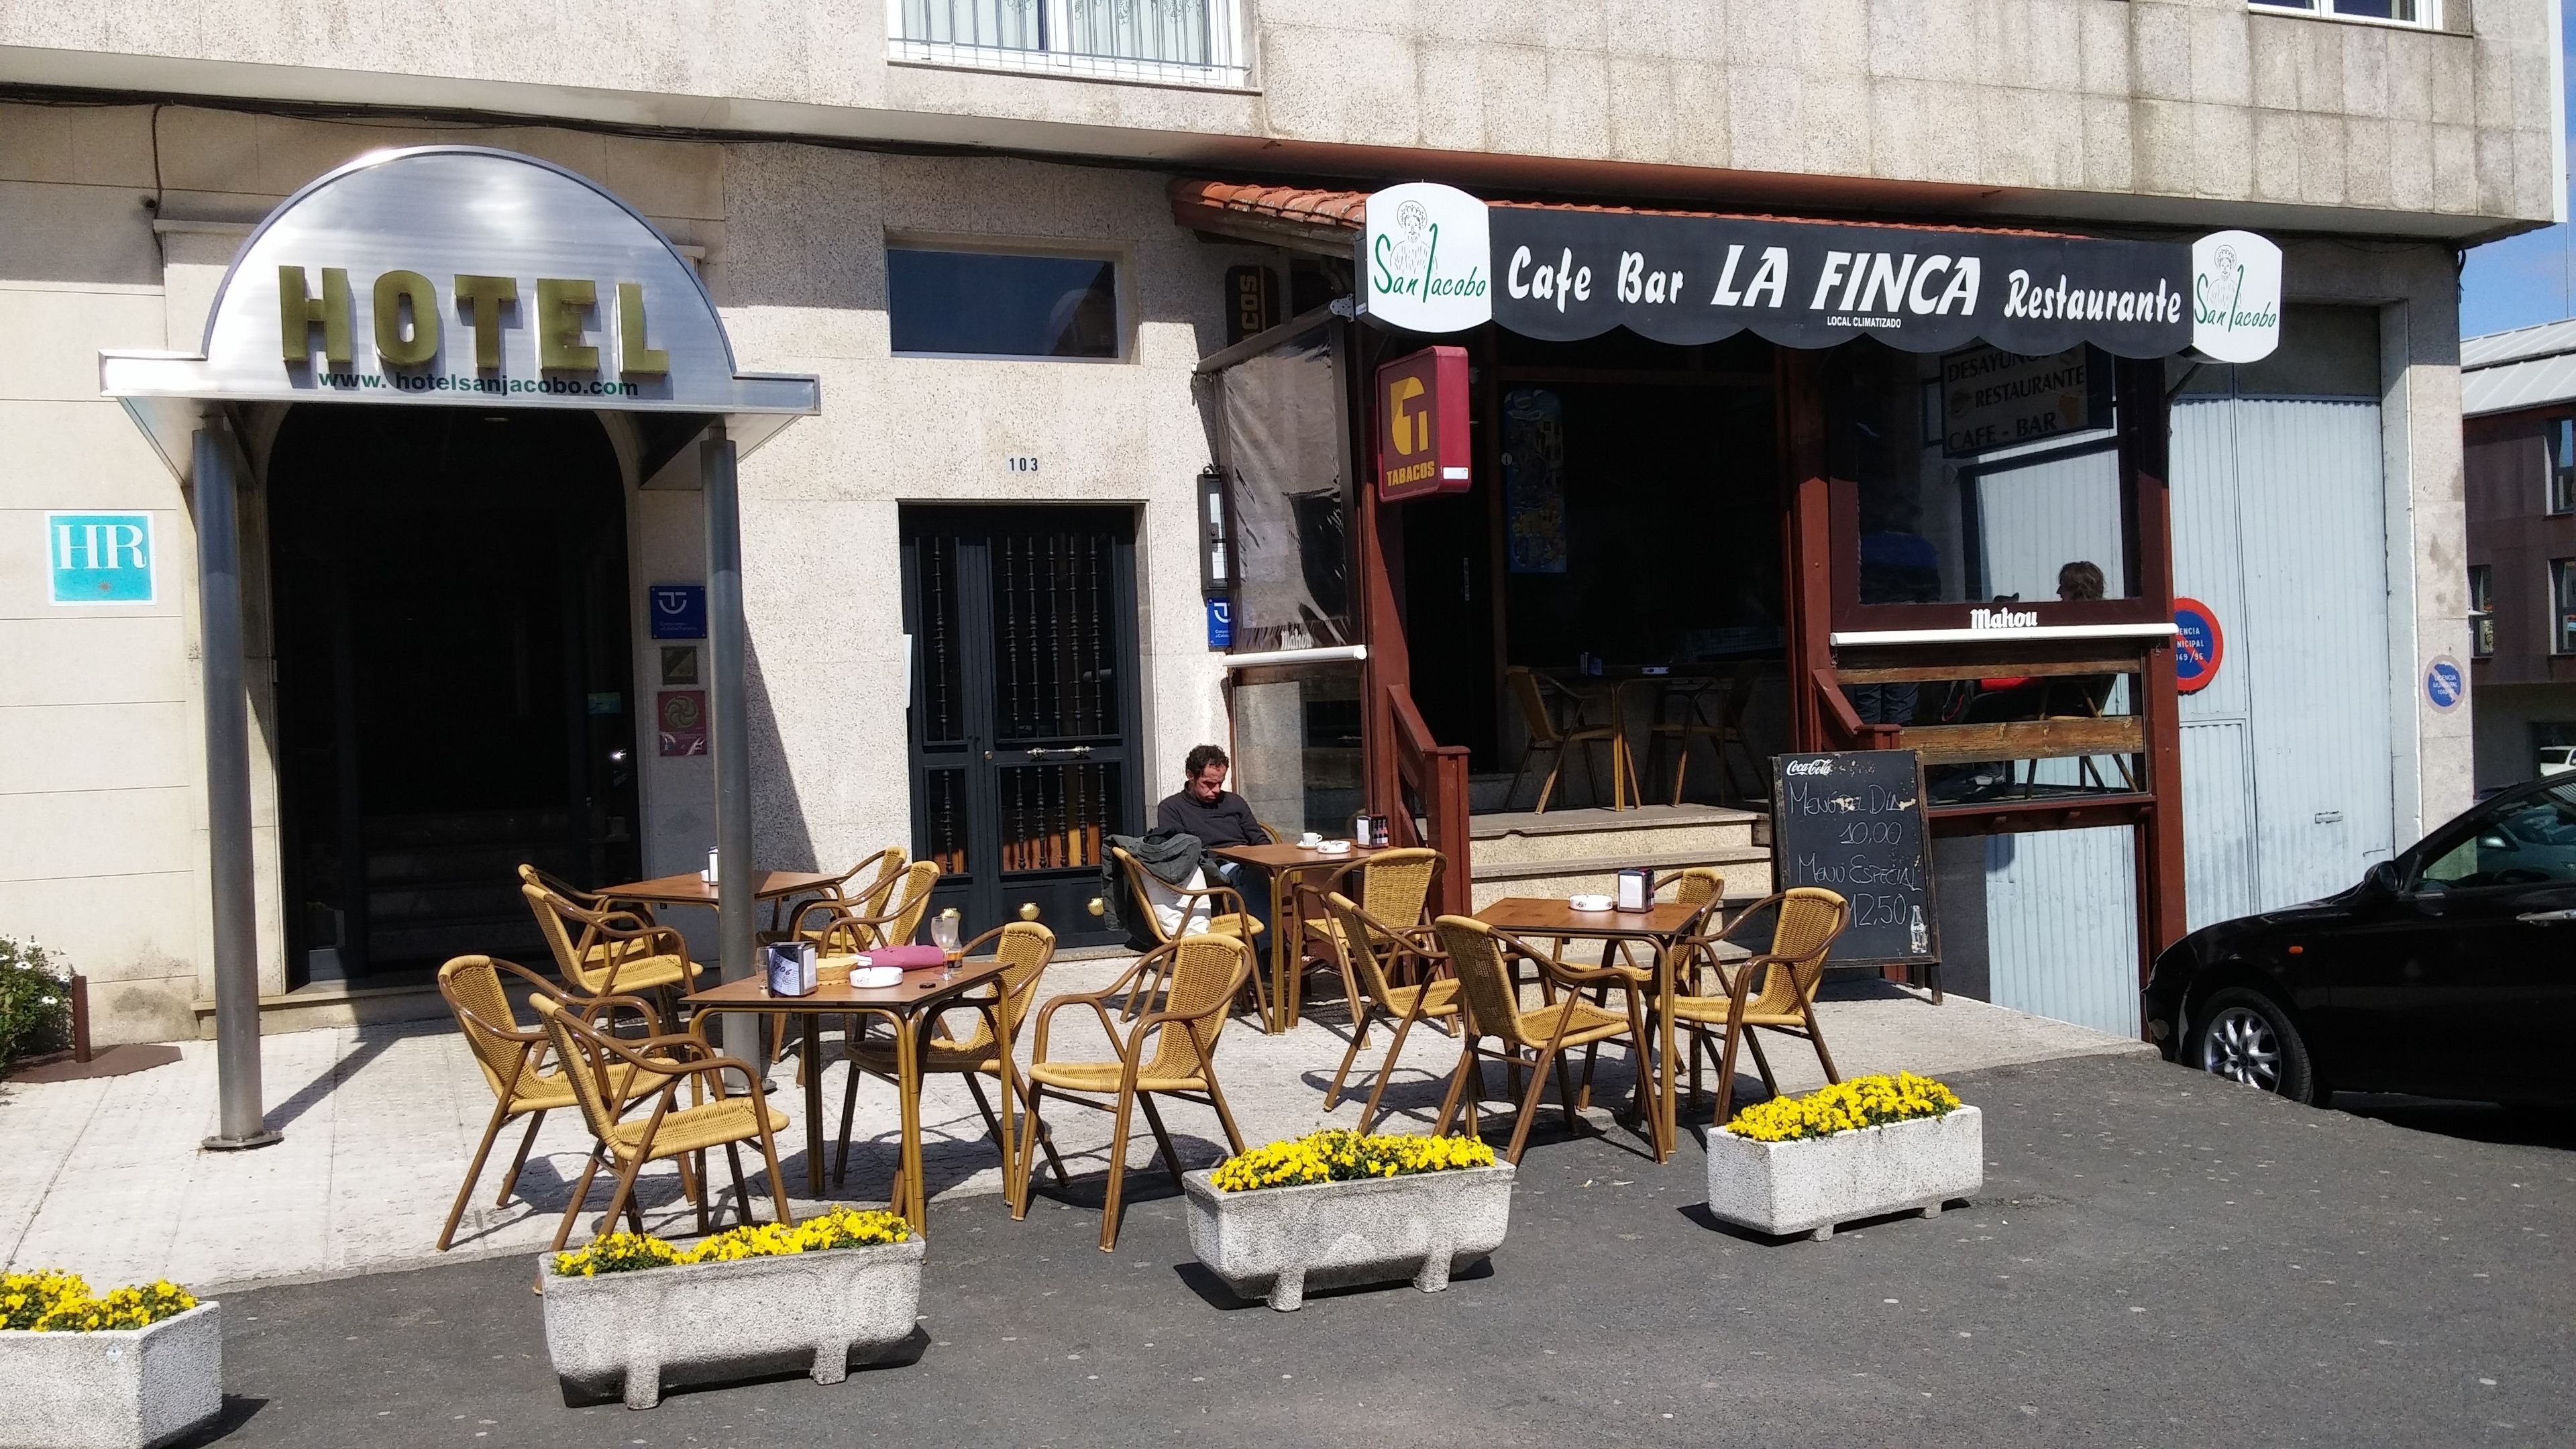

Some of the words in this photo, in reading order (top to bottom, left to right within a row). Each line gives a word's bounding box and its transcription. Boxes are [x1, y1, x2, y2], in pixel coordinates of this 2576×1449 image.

[1374, 233, 1418, 294] San
[1507, 245, 1591, 313] Cafe
[1617, 250, 1683, 304] Bar
[1710, 244, 1788, 308] LA
[1809, 250, 1981, 315] FINCA
[2004, 269, 2182, 323] Restaurante
[2194, 272, 2226, 326] San
[278, 265, 669, 374] HOTEL
[1827, 316, 1851, 326] LOCAL
[1853, 317, 1902, 329] CLIMATIZADO
[396, 373, 638, 396] hotelsanjacobo.com
[1975, 364, 2085, 409] RESTAURANTE
[1947, 425, 1996, 451] CAFE
[2016, 411, 2058, 437] BAR
[1009, 458, 1038, 472] 103
[1386, 460, 1436, 487] TABACOS
[55, 525, 147, 569] HR
[1970, 606, 2039, 629] Mahou
[2179, 627, 2201, 635] ENCIA
[2177, 639, 2205, 649] NICIPAL
[1839, 822, 1902, 845] 10,00
